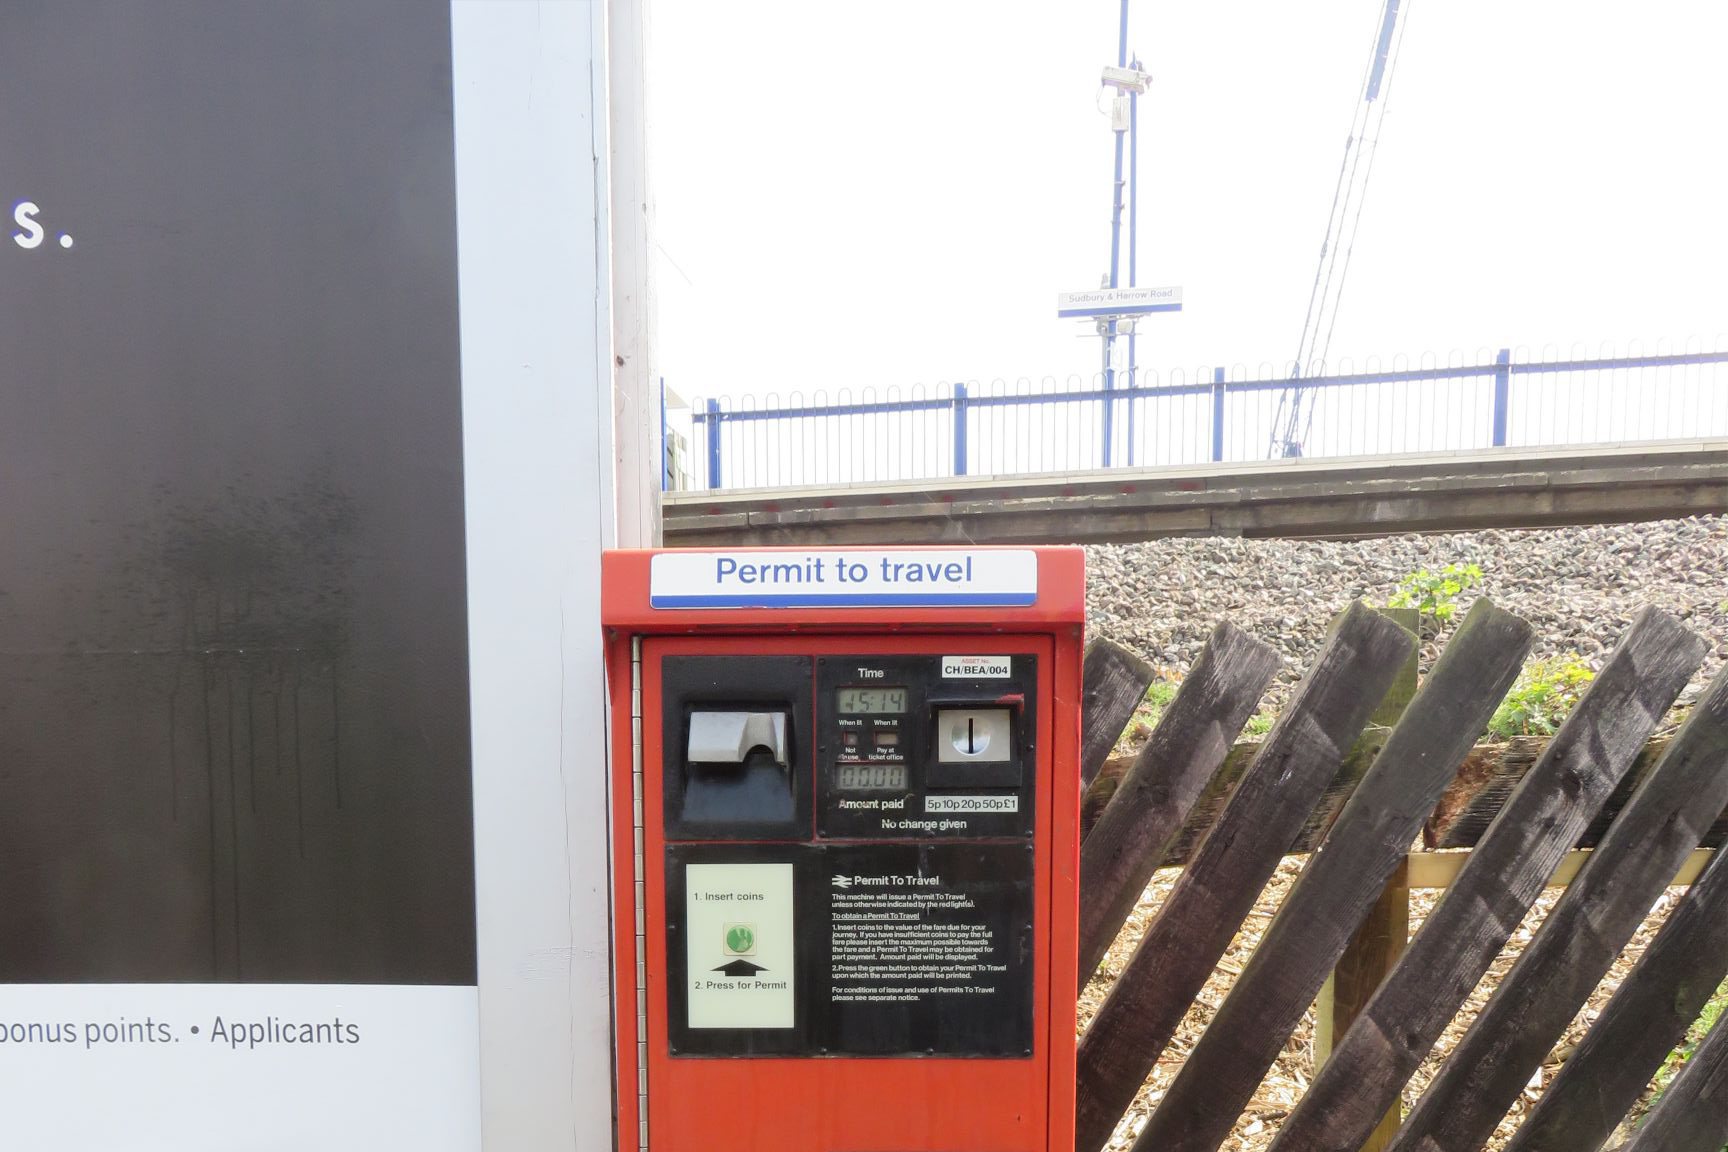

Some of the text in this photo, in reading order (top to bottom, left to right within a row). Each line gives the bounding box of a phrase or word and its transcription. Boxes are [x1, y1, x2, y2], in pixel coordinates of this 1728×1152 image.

[1068, 289, 1173, 303] Sudbury & Harrow Road
[716, 556, 972, 584] Permit to travel
[857, 667, 884, 678] Time
[945, 665, 1008, 675] CH/BEA/004
[838, 799, 904, 811] Amount paid
[927, 799, 1016, 811] 5p 10p 20p 50p £1
[881, 819, 967, 831] No change given
[854, 875, 940, 886] Permit To Travel
[694, 892, 764, 901] 1. Insert coins
[918, 901, 926, 909] by
[694, 981, 787, 990] 2. Press for Permit
[85, 1017, 180, 1049] points.
[210, 1016, 361, 1049] Applicants
